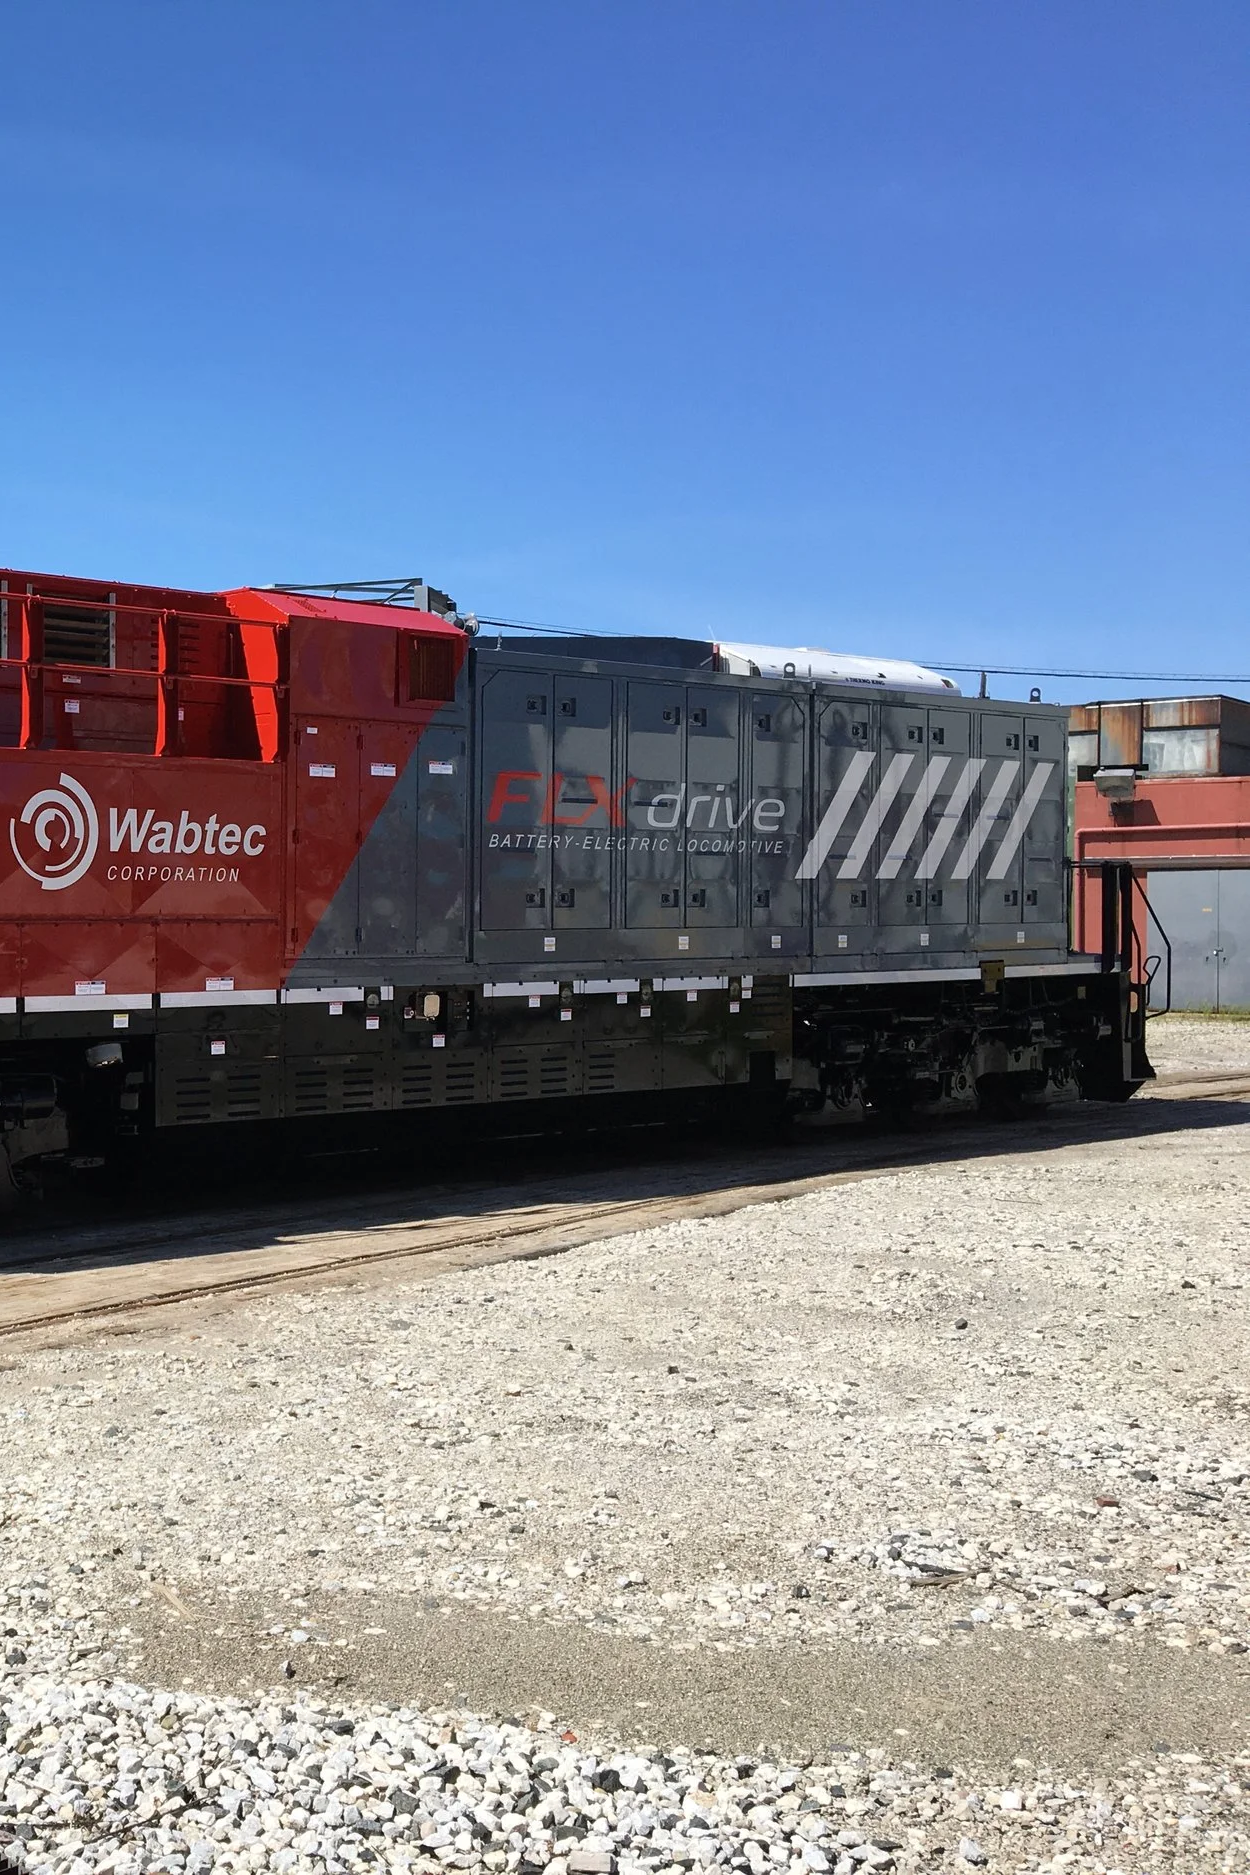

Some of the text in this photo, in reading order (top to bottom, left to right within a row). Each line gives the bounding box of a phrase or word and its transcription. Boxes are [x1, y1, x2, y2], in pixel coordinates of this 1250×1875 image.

[647, 782, 786, 832] drive
[109, 807, 267, 856] Wabtec
[488, 833, 784, 855] BATTERY-ELECTRIC LOCOMOTIVE
[107, 865, 240, 882] CORPORATION
